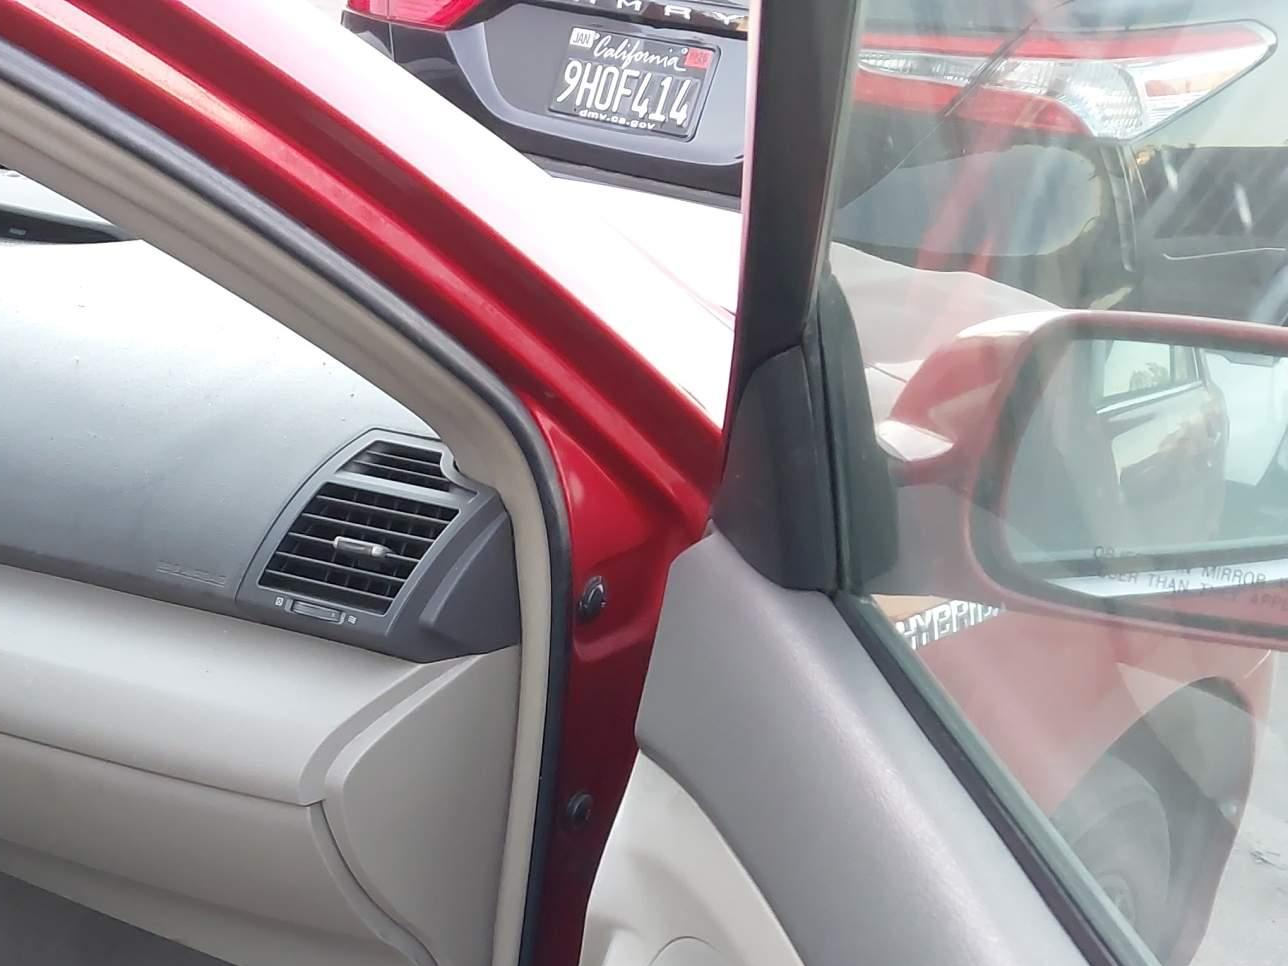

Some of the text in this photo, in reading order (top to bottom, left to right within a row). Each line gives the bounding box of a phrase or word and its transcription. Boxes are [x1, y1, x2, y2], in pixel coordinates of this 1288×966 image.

[593, 35, 687, 72] California
[578, 108, 656, 130] dmv.ca.gov
[1147, 573, 1190, 594] THAN
